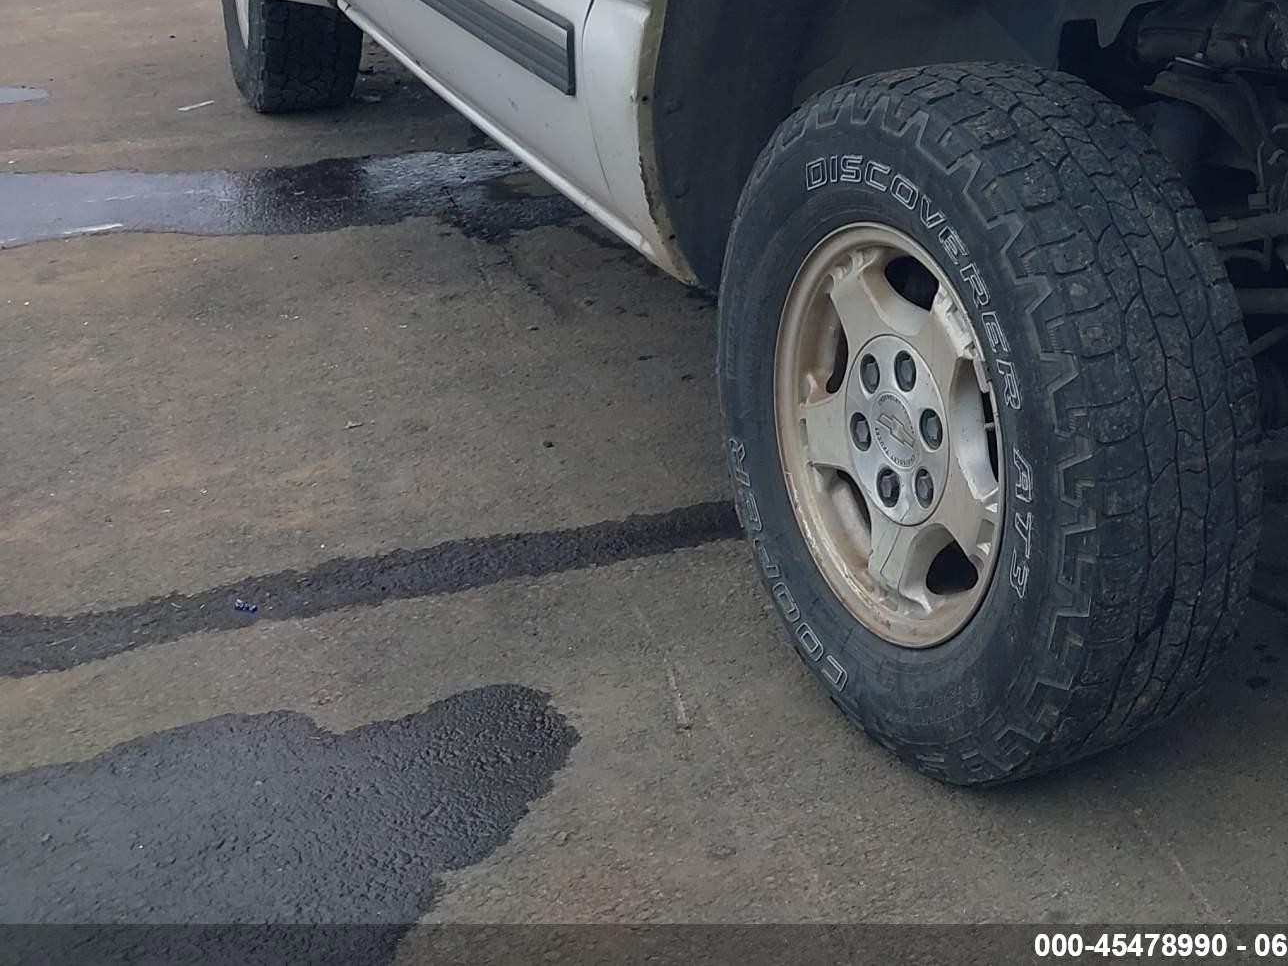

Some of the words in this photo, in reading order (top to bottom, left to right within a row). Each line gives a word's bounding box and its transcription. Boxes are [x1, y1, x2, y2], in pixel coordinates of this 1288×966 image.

[805, 153, 1024, 411] DISCOVERER
[1009, 447, 1033, 599] AT3
[728, 436, 848, 693] COOPER
